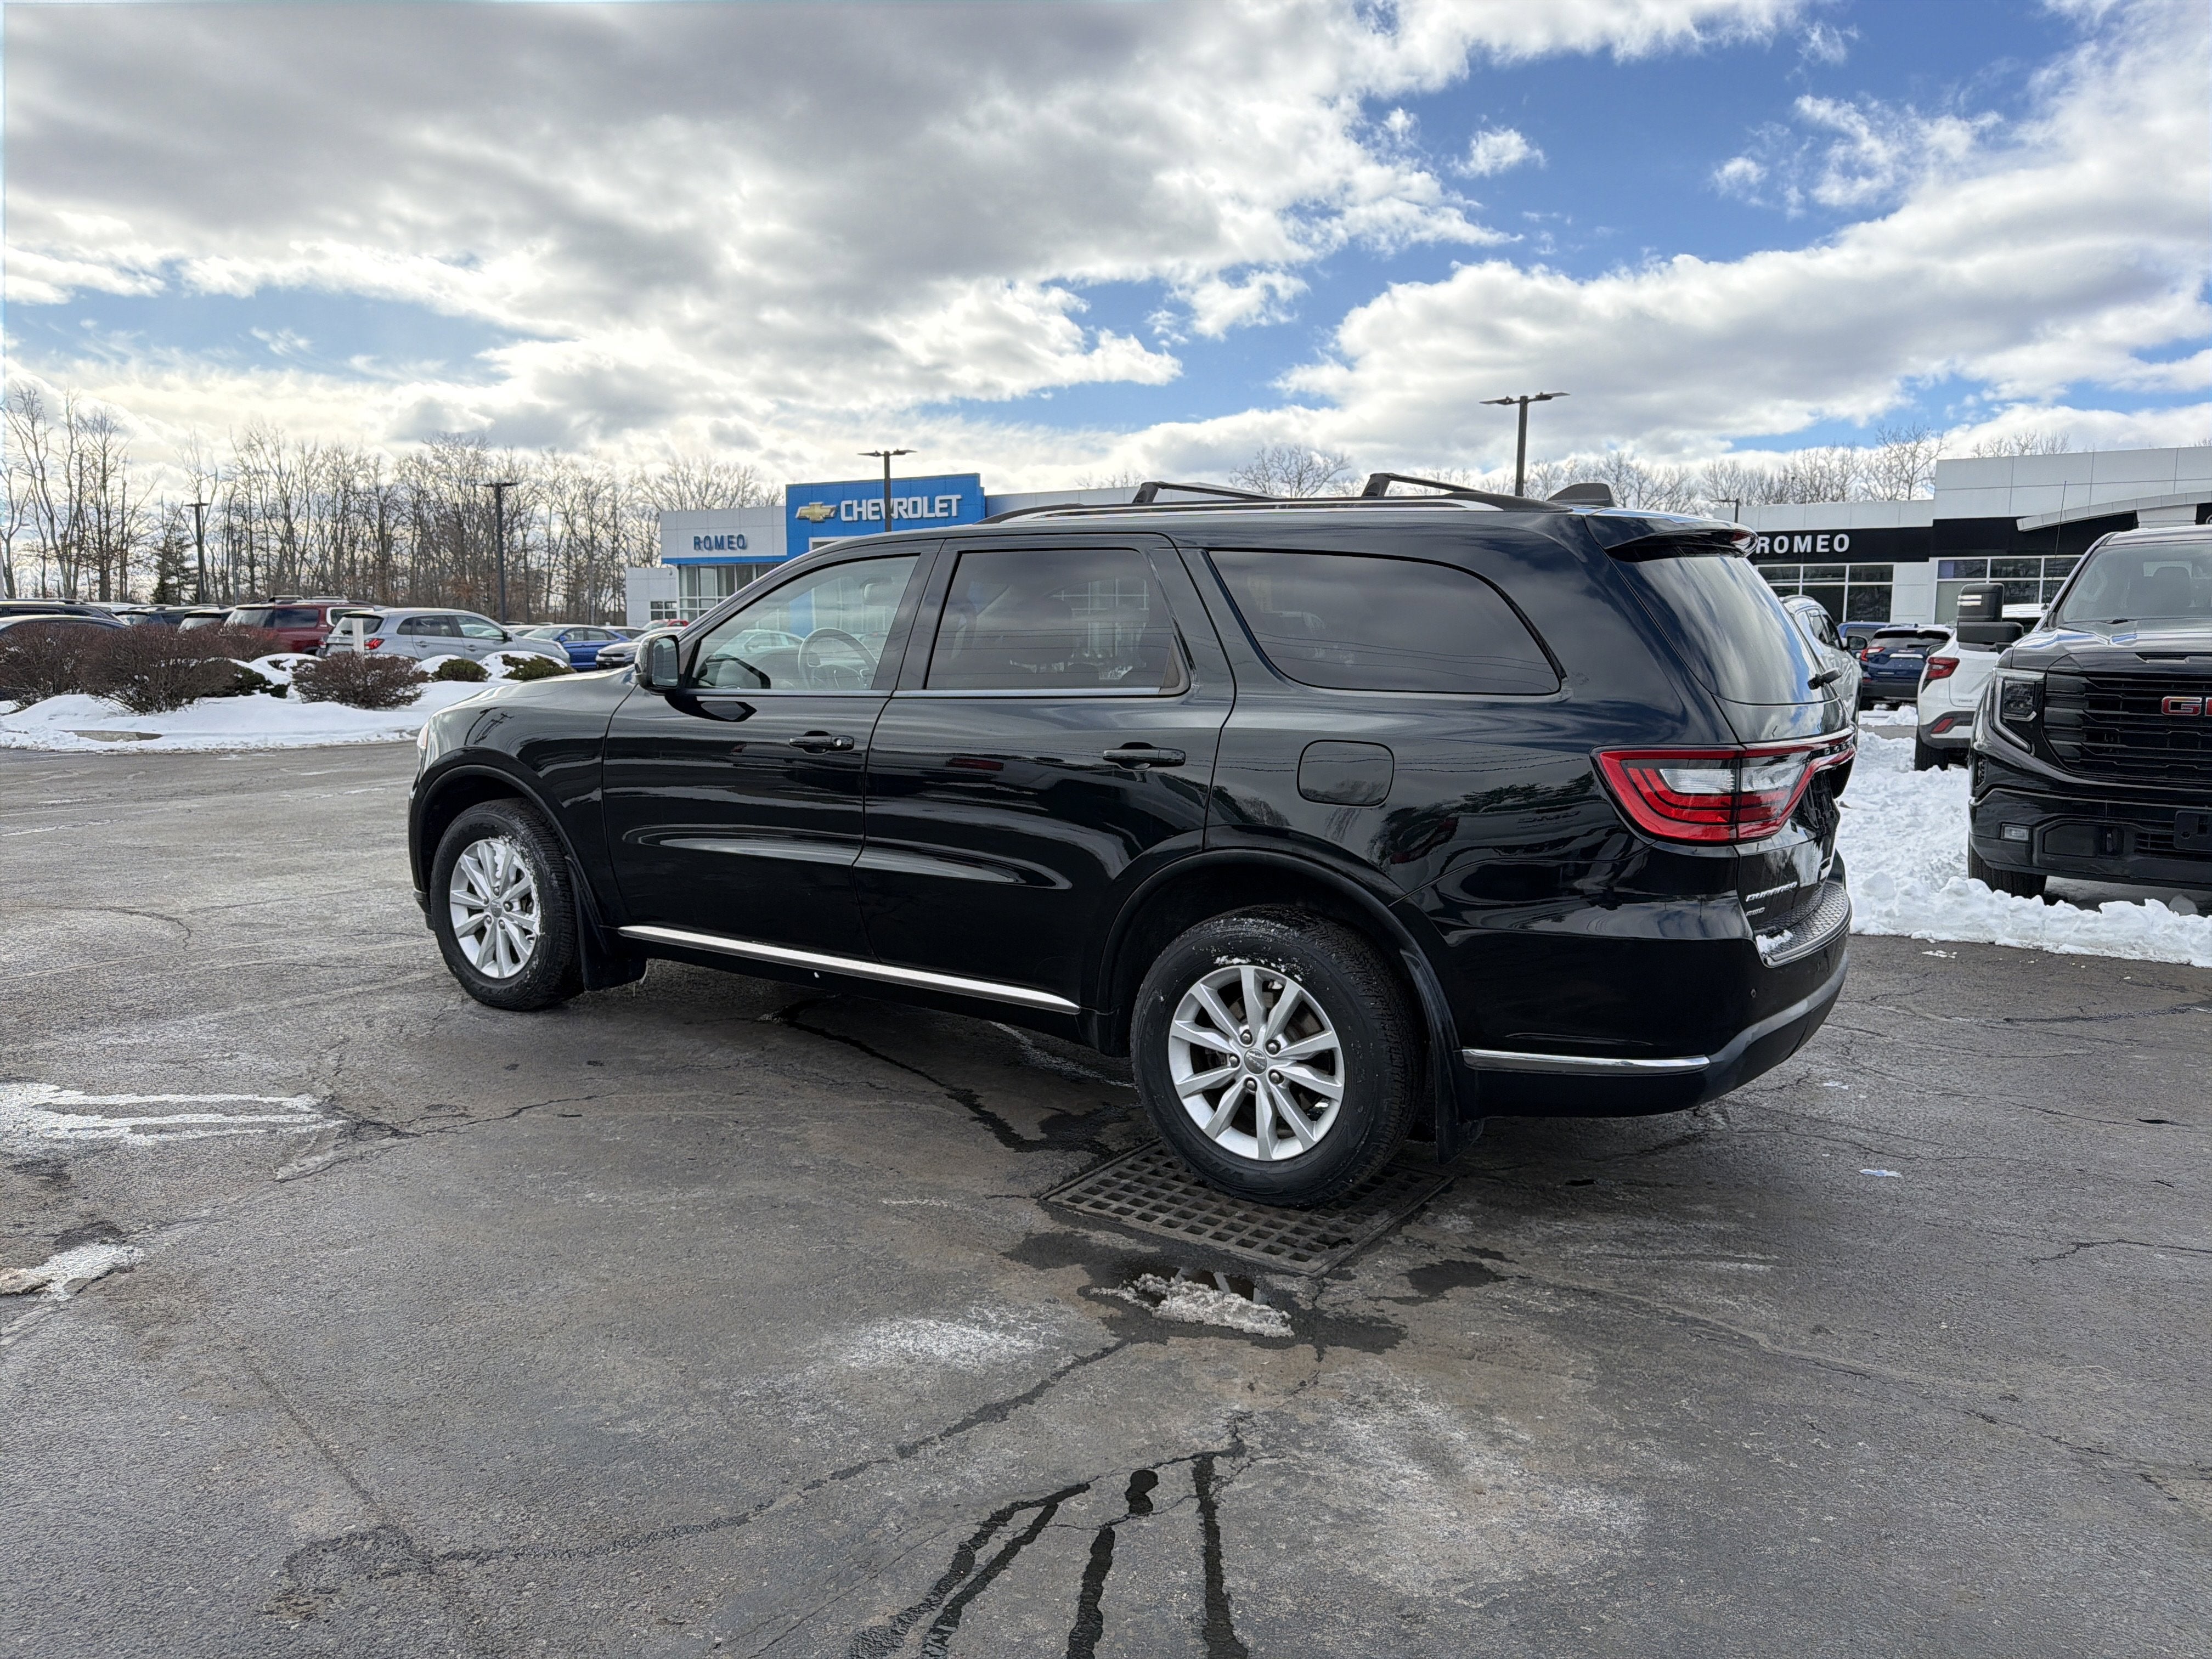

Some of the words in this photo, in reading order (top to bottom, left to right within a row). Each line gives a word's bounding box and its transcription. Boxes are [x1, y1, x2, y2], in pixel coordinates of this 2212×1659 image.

[693, 534, 747, 550] ROMEO
[1756, 534, 1849, 554] ROMEO
[2162, 696, 2212, 716] G
